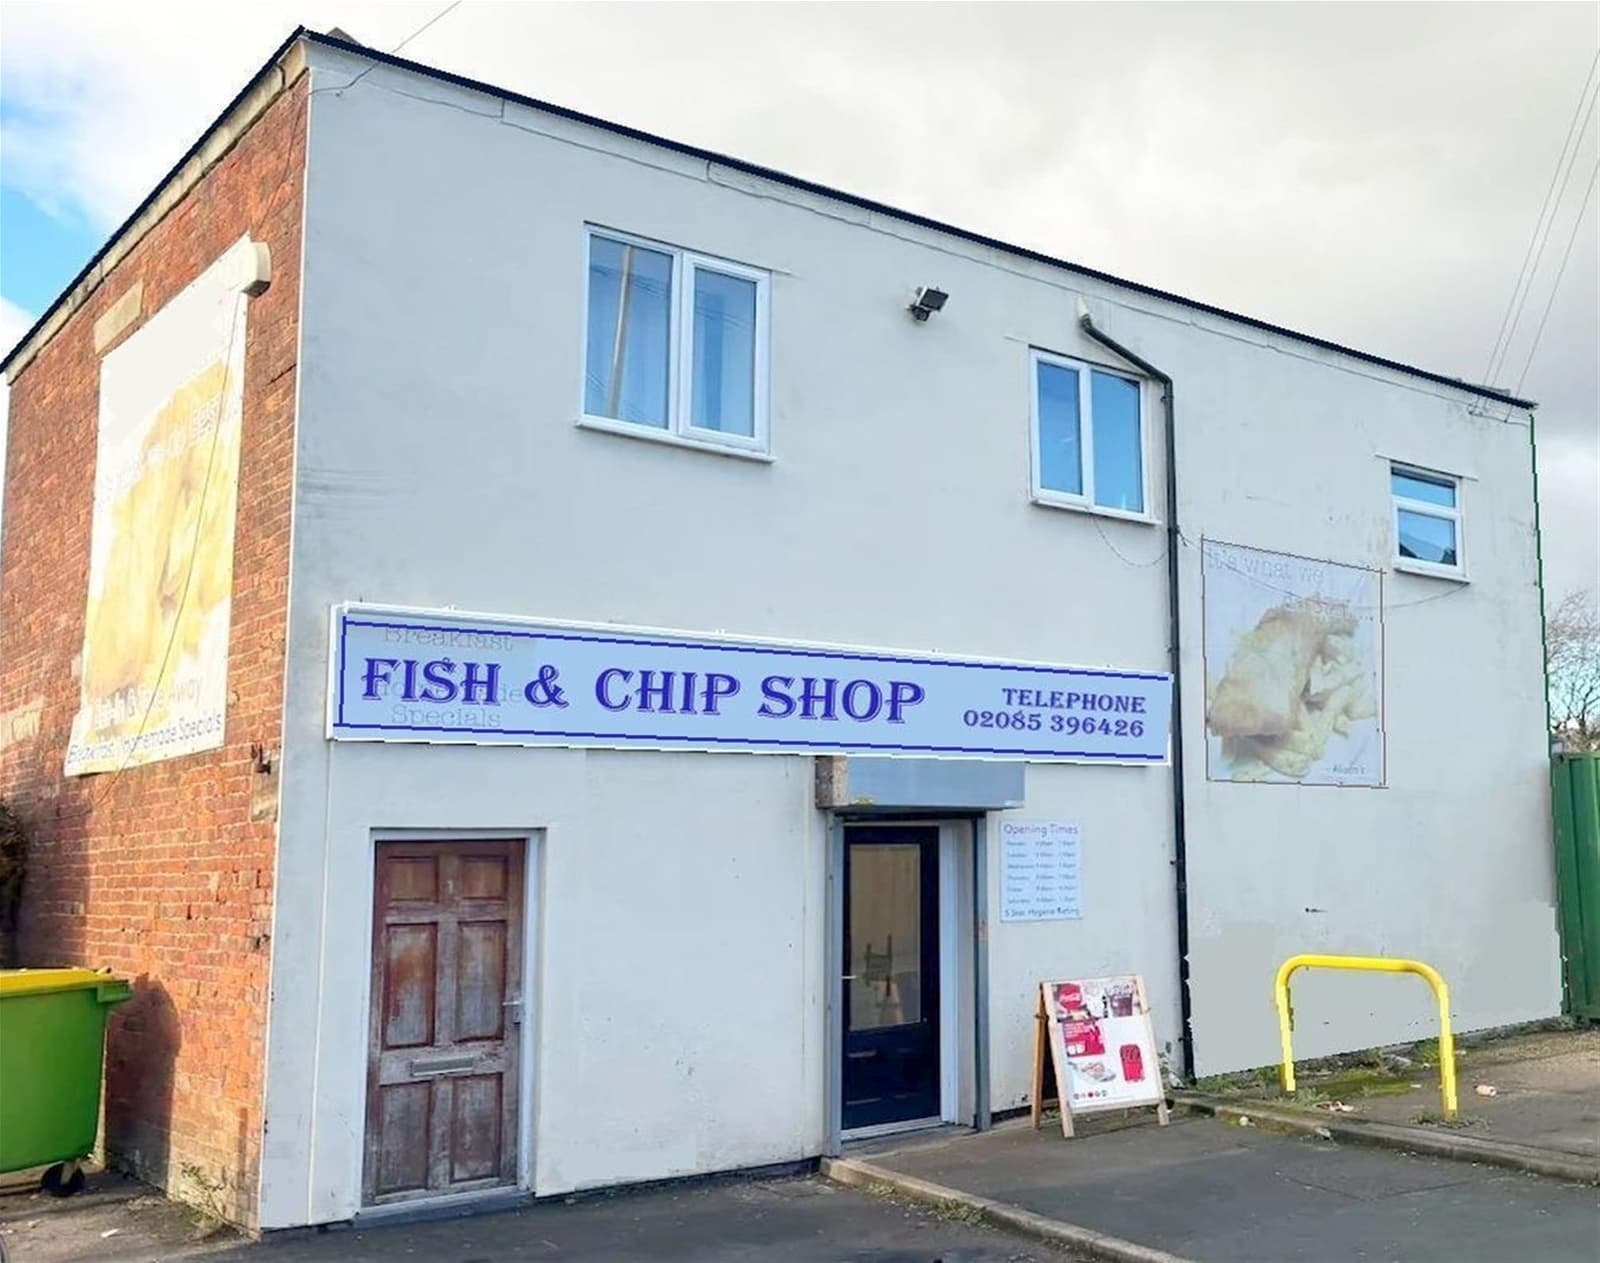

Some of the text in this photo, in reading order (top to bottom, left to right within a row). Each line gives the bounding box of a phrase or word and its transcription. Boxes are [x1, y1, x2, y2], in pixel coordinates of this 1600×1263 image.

[361, 657, 501, 707] FISH
[524, 664, 569, 710] &
[595, 667, 741, 716] CHIP
[757, 675, 925, 724] SHOP
[1001, 687, 1147, 714] TELEPHONE
[391, 703, 502, 728] Specials
[963, 709, 1144, 738] 02085 396426
[1003, 823, 1079, 838] Opening Times
